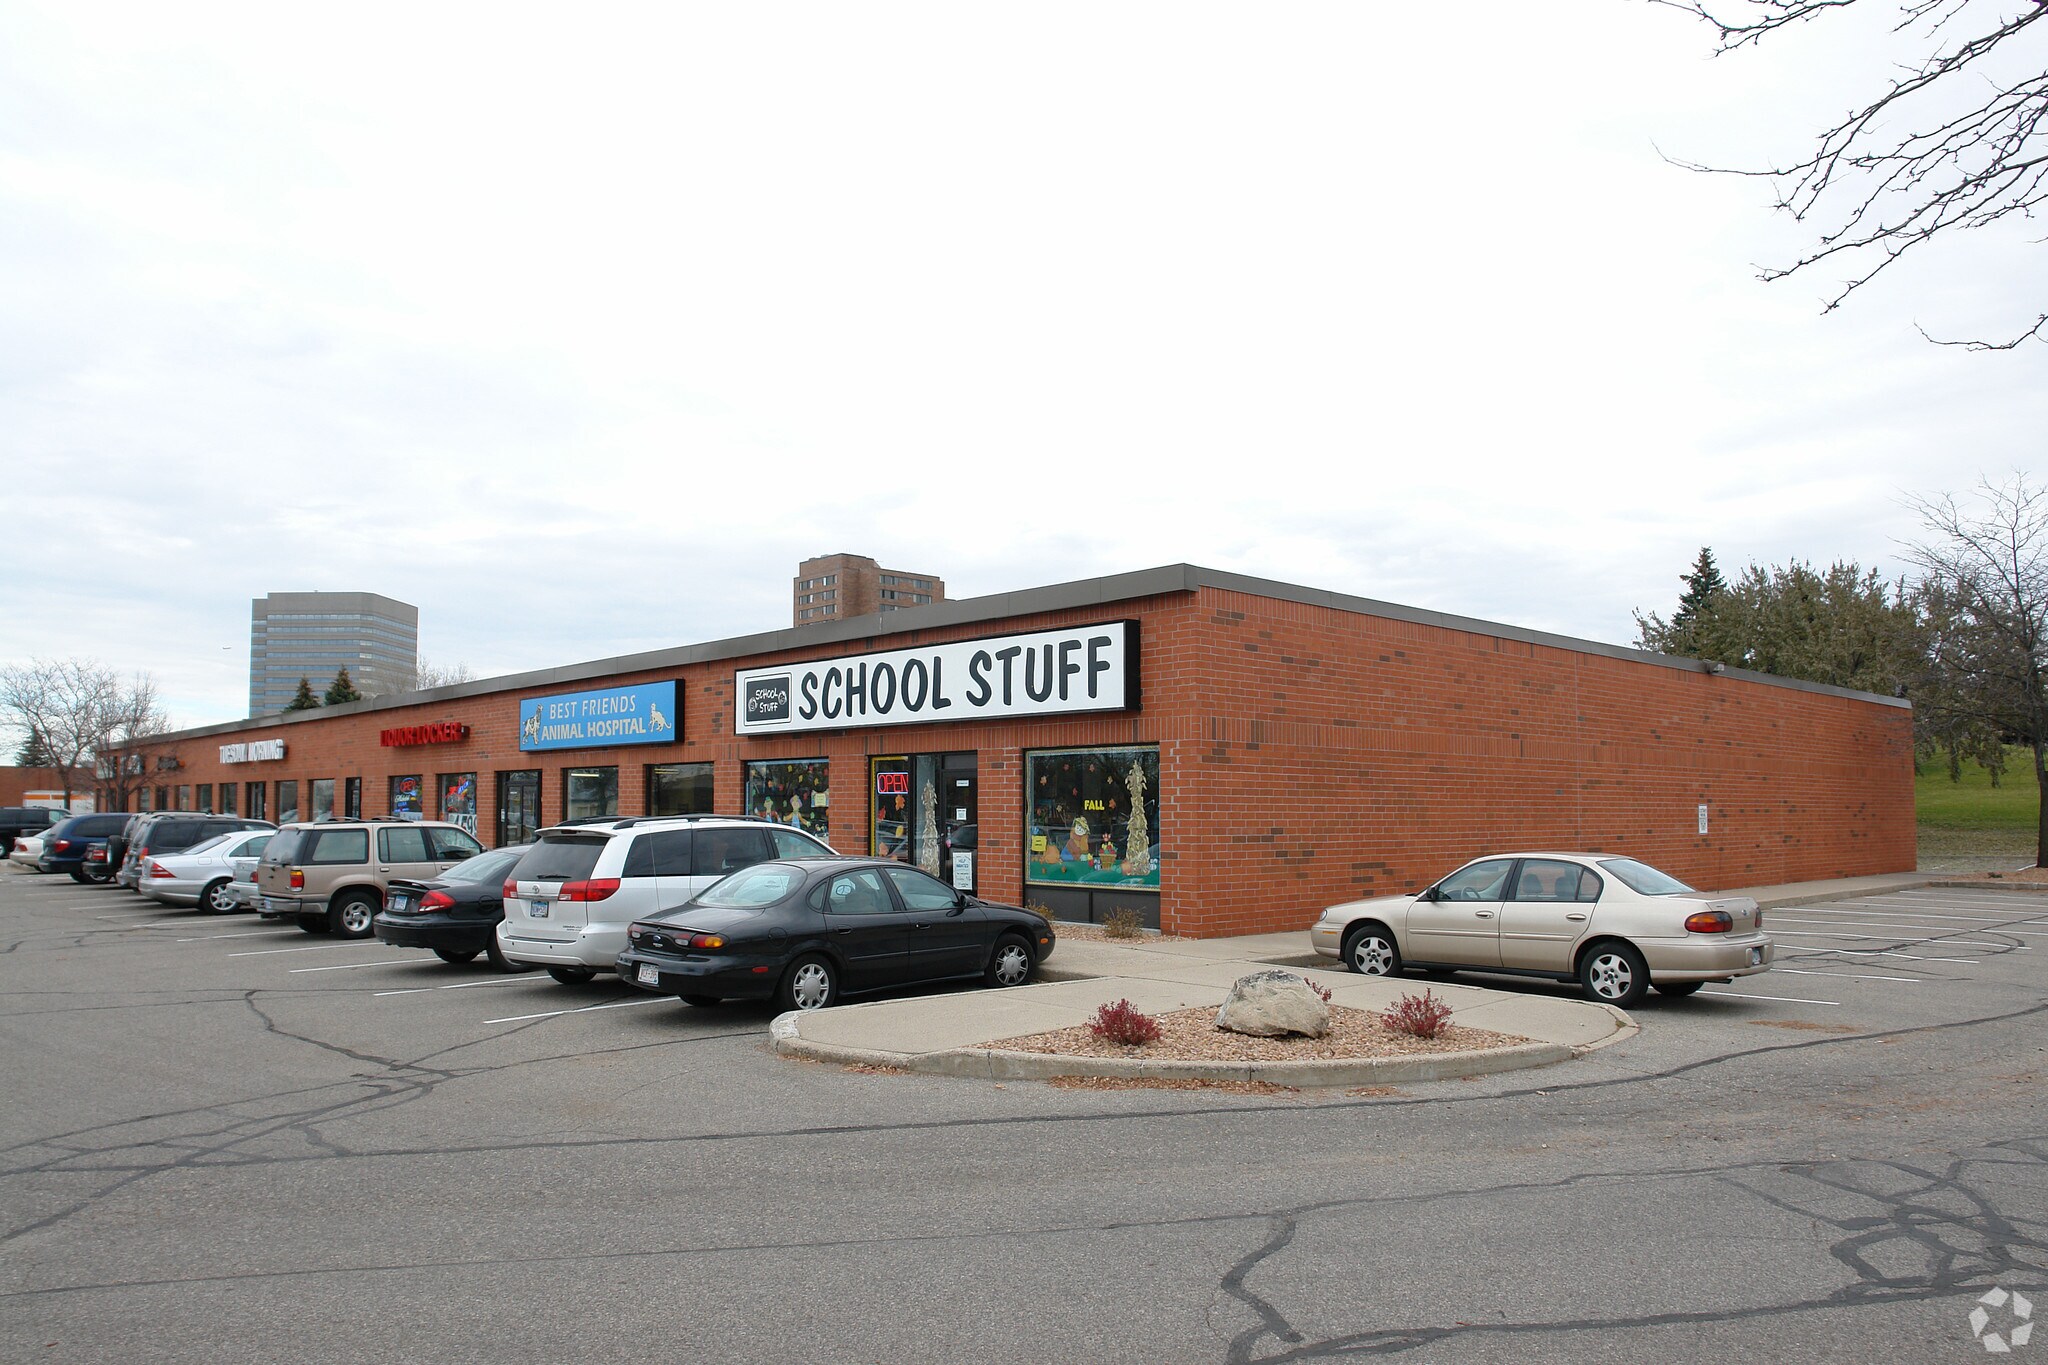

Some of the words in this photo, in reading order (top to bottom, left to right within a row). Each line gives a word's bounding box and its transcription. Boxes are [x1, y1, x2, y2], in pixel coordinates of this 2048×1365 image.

[798, 656, 952, 720] SCHOOL
[966, 636, 1112, 706] STUFF
[755, 688, 778, 700] SCHOOL
[550, 702, 577, 719] BEST
[582, 695, 636, 716] FRIENDS
[759, 702, 778, 713] STUFF
[416, 722, 461, 744] LOCKER
[541, 721, 584, 741] ANIMAL
[587, 717, 646, 738] HOSPITAL
[219, 743, 248, 764] TUESDAY
[248, 739, 284, 762] MORNING
[878, 774, 909, 793] OPEN
[1084, 799, 1105, 811] FALL
